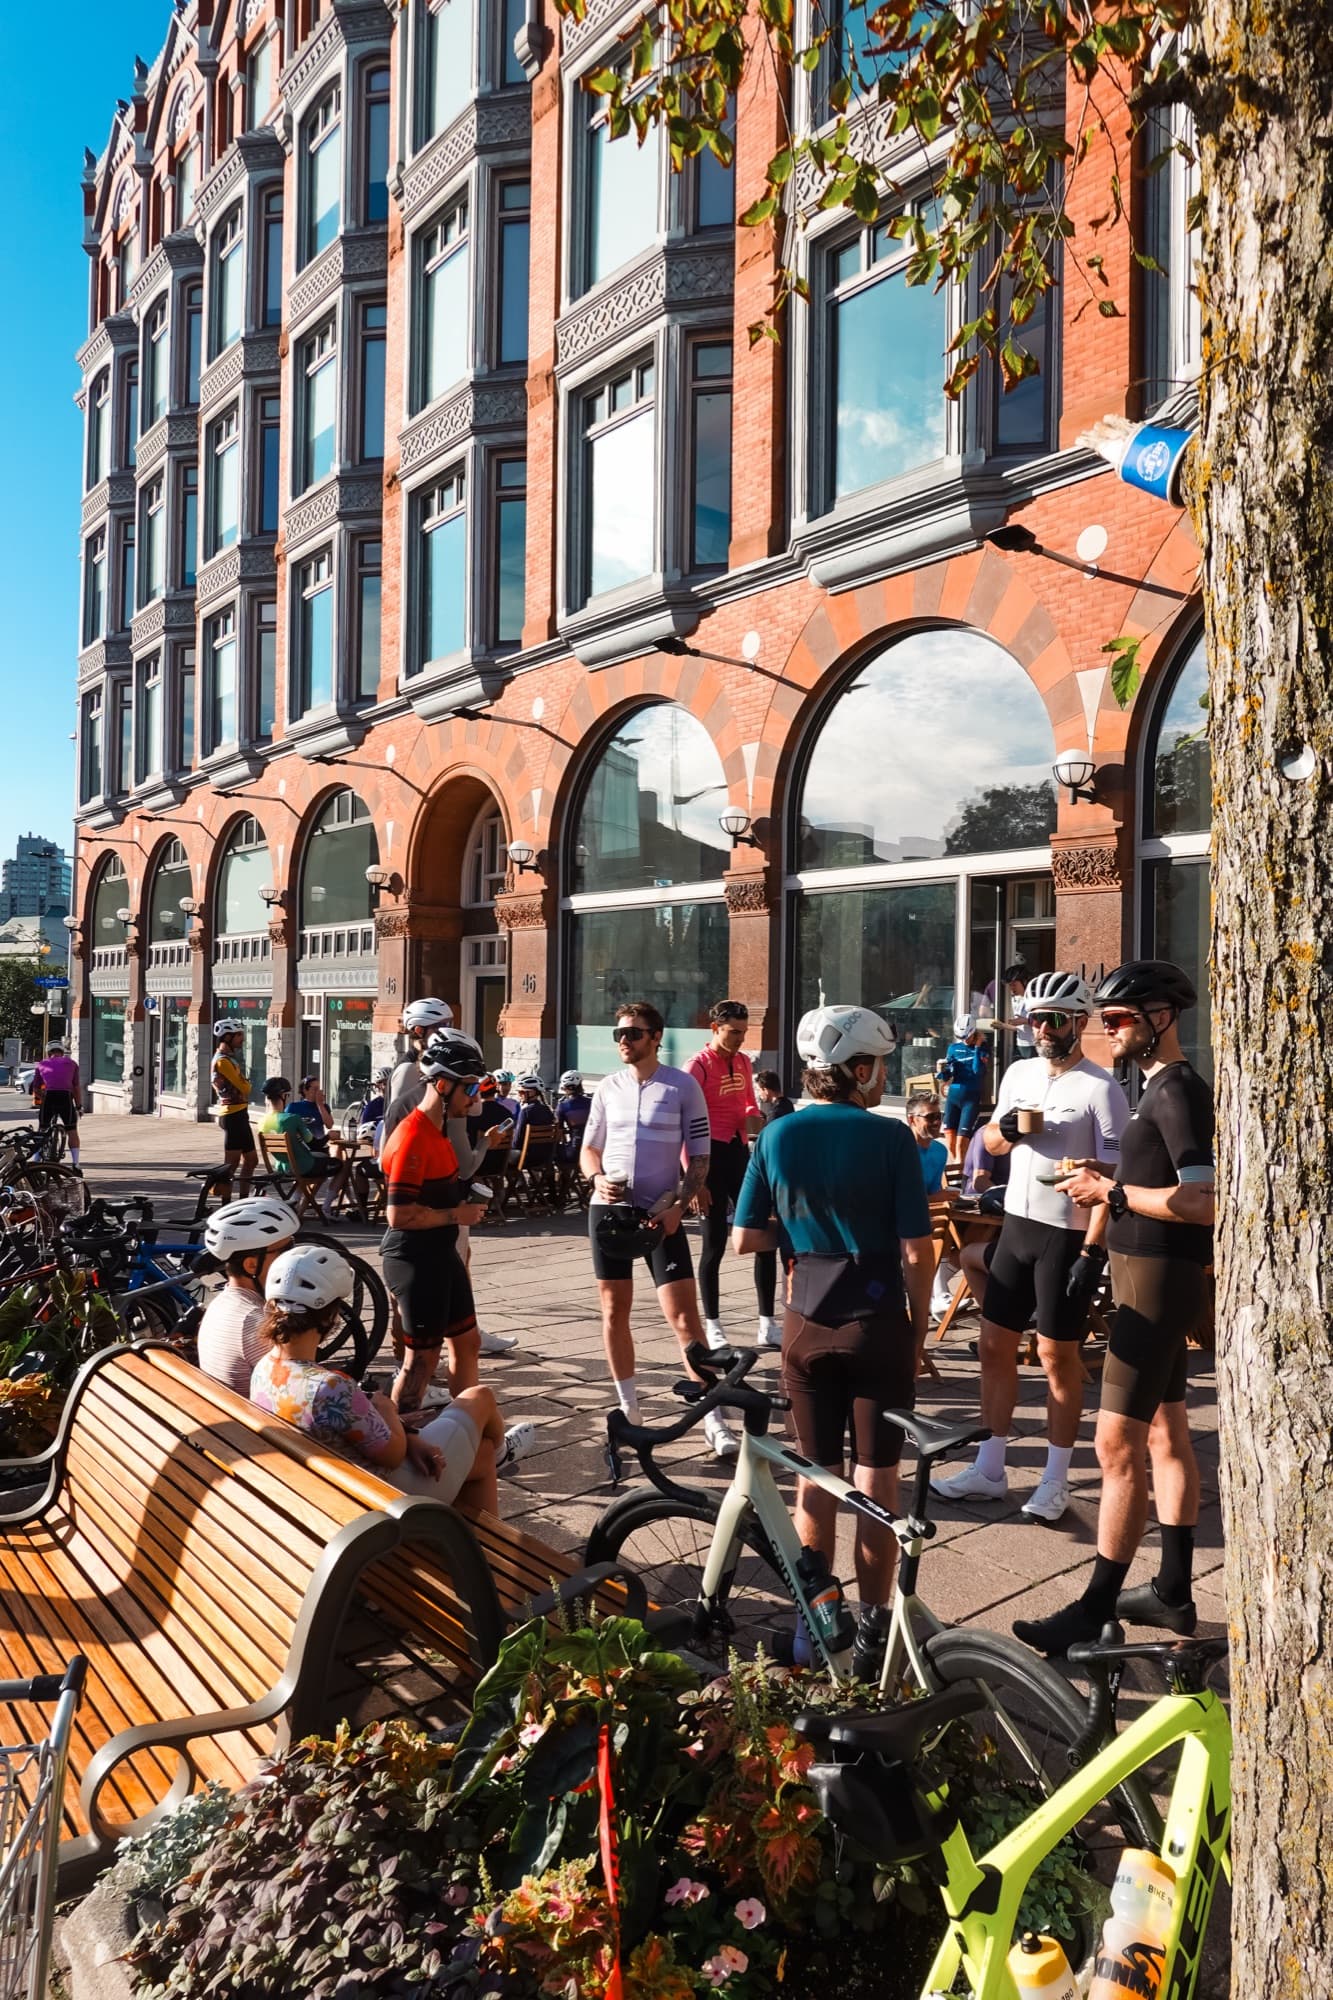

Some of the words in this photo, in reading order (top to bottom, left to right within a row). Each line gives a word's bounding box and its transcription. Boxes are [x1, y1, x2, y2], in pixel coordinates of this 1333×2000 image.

[385, 976, 397, 995] 46
[522, 973, 536, 994] 46
[336, 1018, 357, 1030] Visitor
[357, 1019, 373, 1031] Cent
[1147, 1884, 1167, 1900] BIKE
